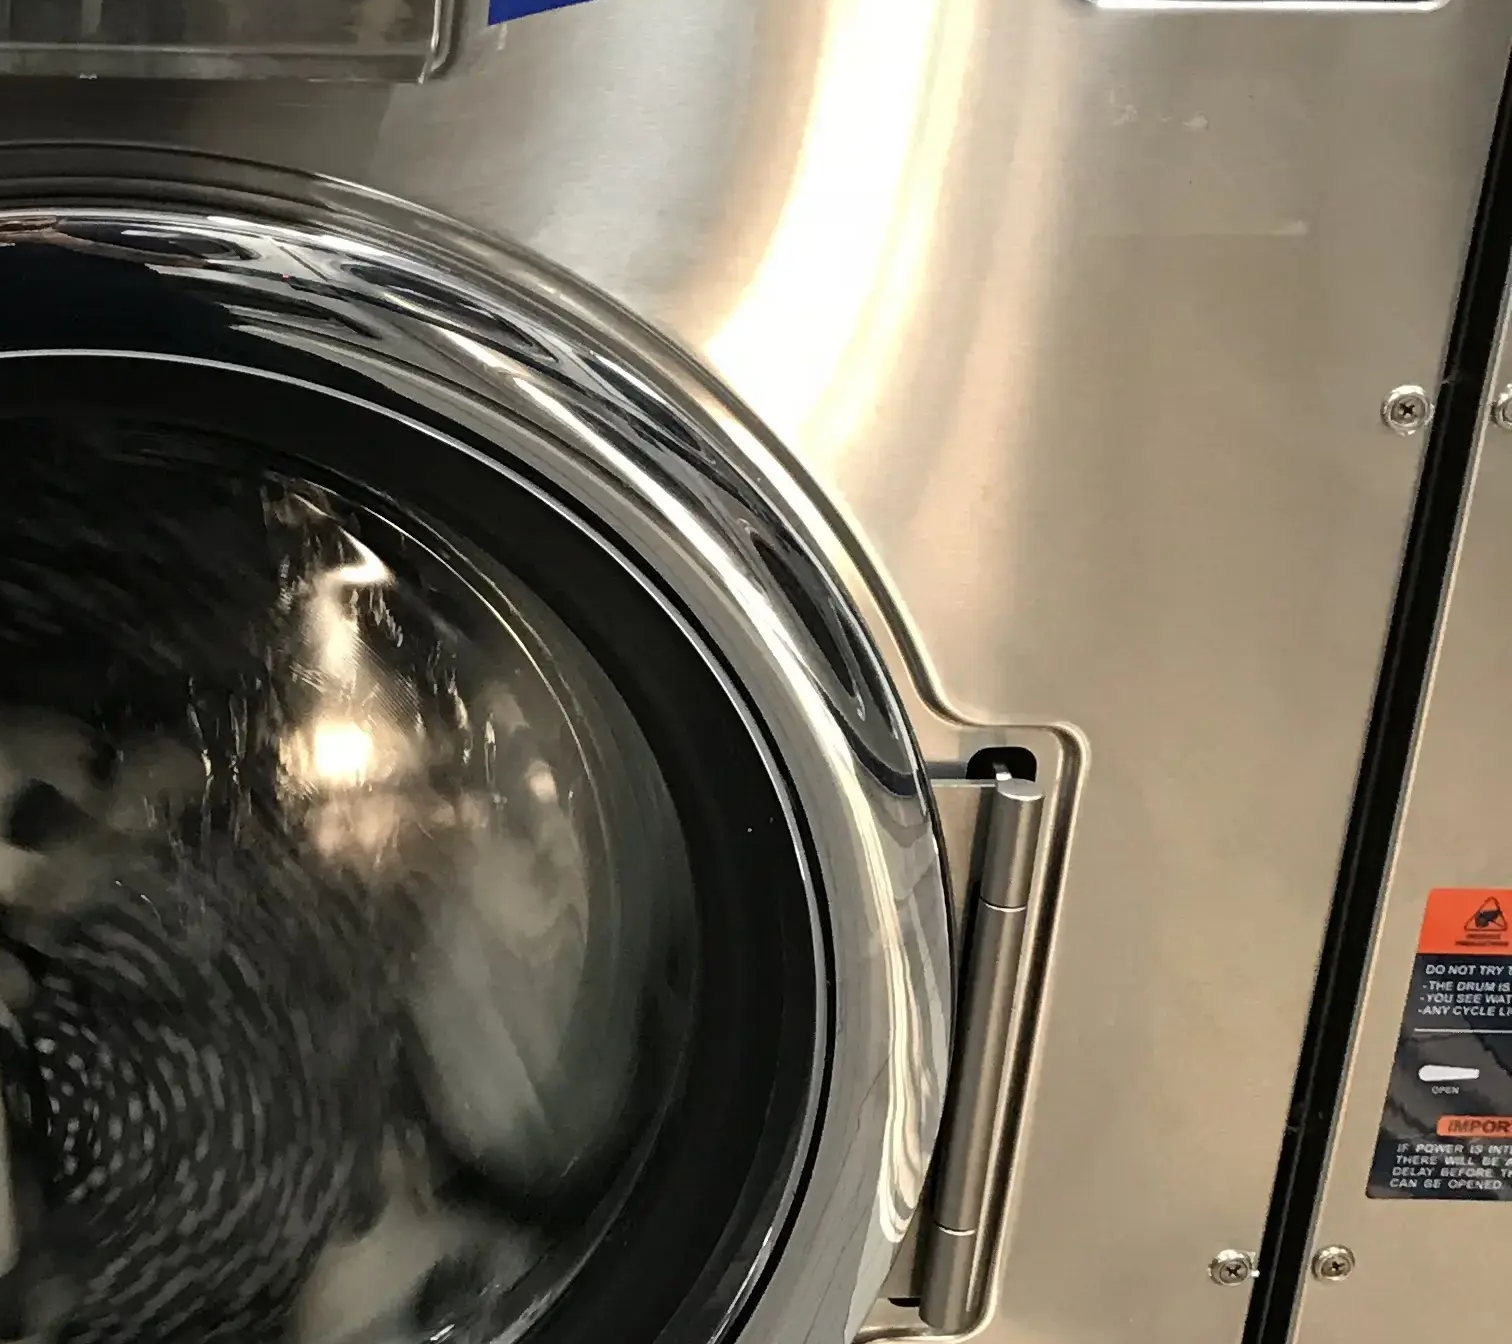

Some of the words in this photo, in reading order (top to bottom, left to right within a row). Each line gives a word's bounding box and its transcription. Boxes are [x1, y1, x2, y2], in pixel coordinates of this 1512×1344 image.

[1425, 964, 1446, 976] DO
[1448, 964, 1476, 976] NOT
[1478, 964, 1504, 976] TRY
